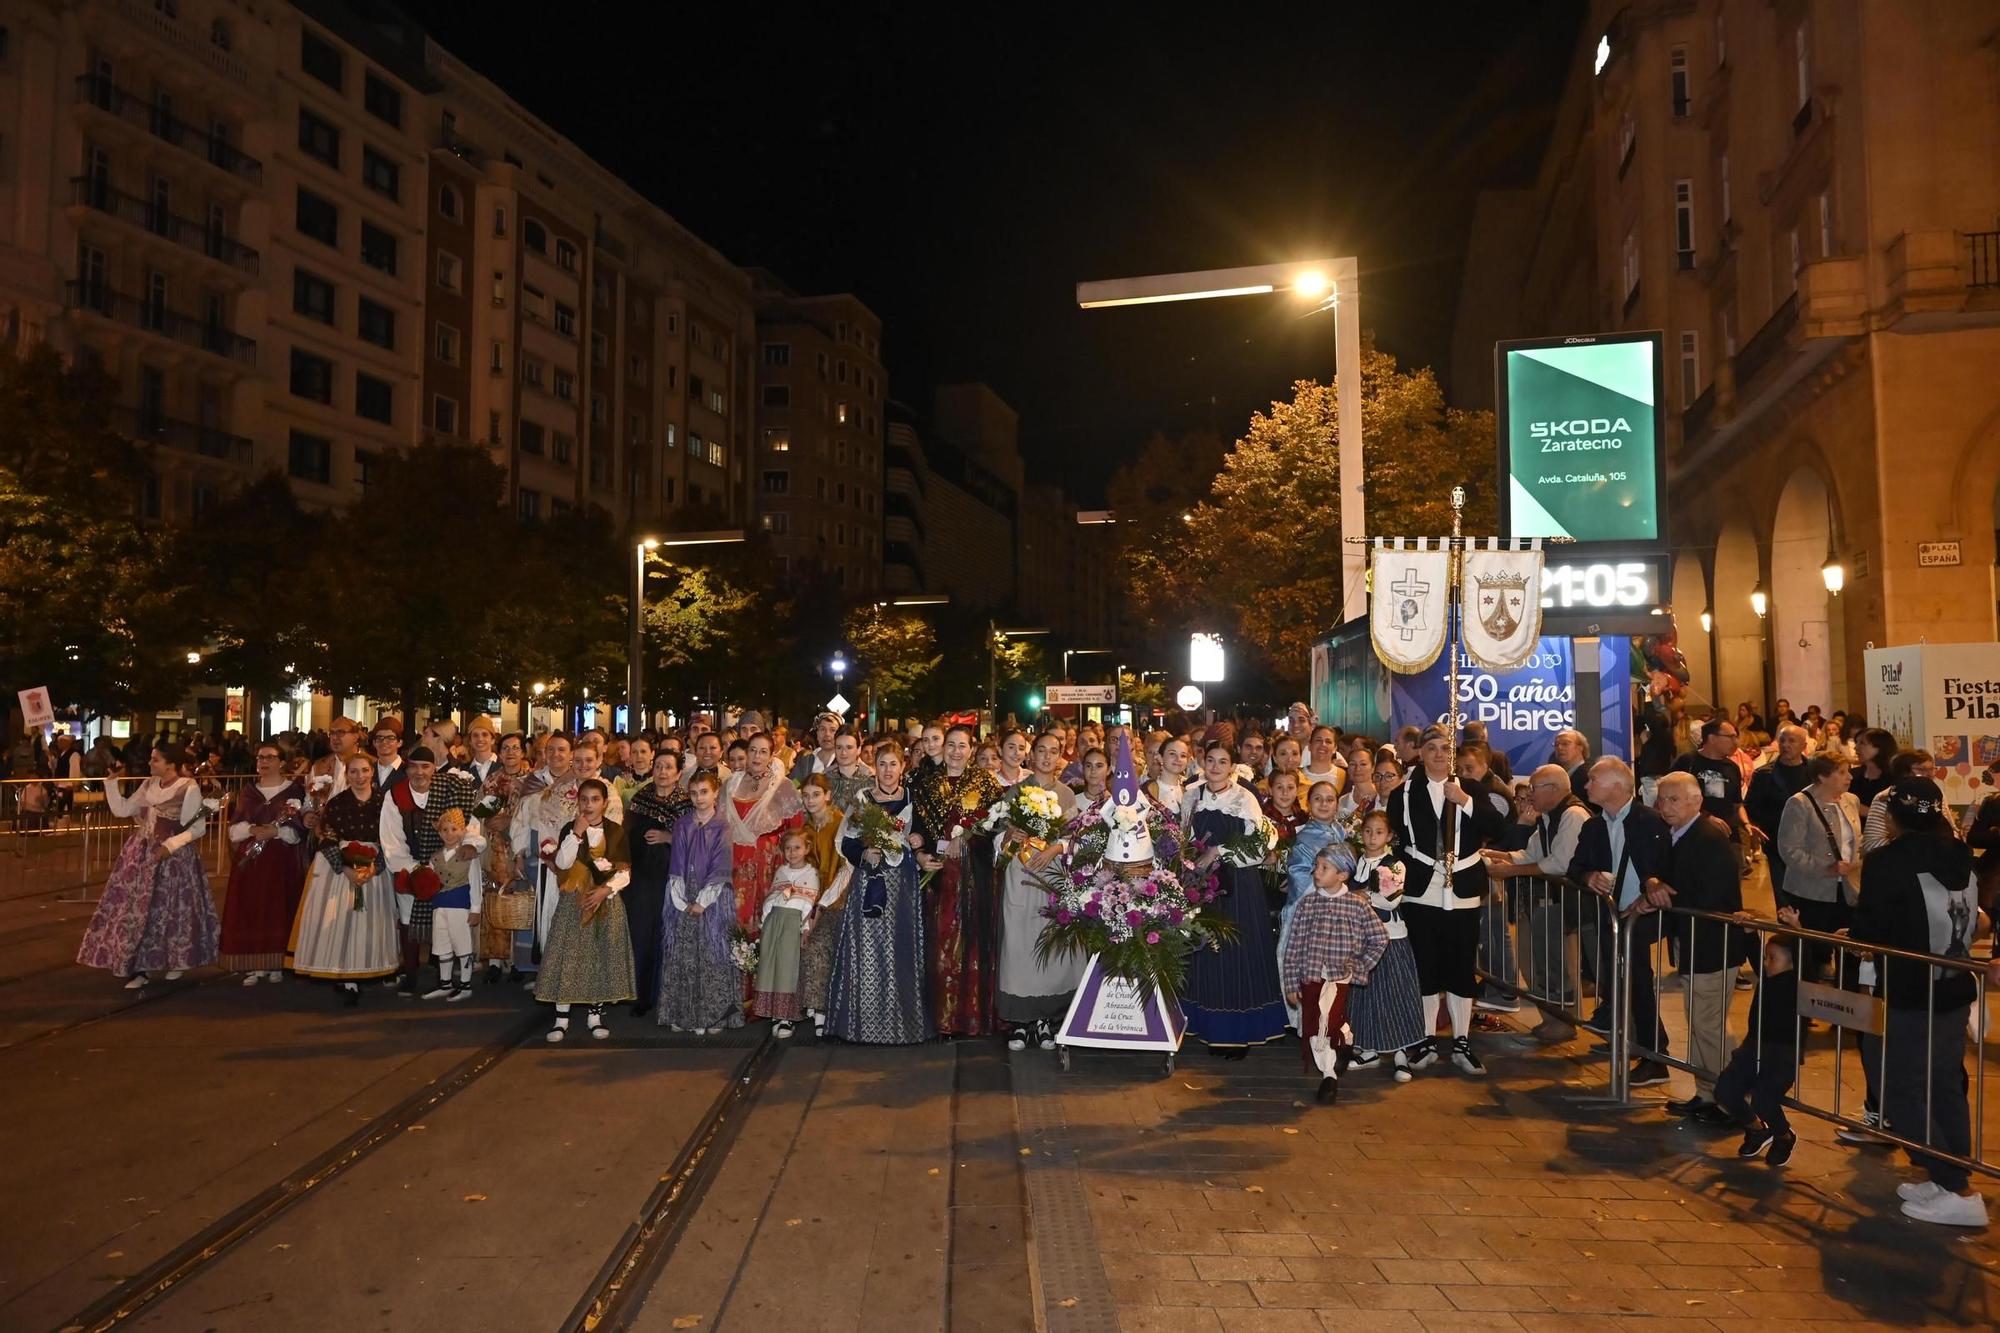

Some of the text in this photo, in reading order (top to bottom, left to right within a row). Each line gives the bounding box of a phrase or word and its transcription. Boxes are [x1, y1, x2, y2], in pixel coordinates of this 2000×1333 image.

[1541, 438, 1622, 453] Zaratecno
[1538, 471, 1627, 484] Avda. Cataluña, 105
[1921, 553, 1958, 564] ESPAÑA
[1881, 663, 1901, 682] Pilar
[1509, 678, 1573, 703] años
[1944, 695, 2000, 719] Pila
[1478, 702, 1574, 731] Pilares
[1110, 1012, 1117, 1020] la
[1118, 1013, 1134, 1021] Cruz
[1099, 1022, 1107, 1030] de
[1108, 1023, 1114, 1031] la
